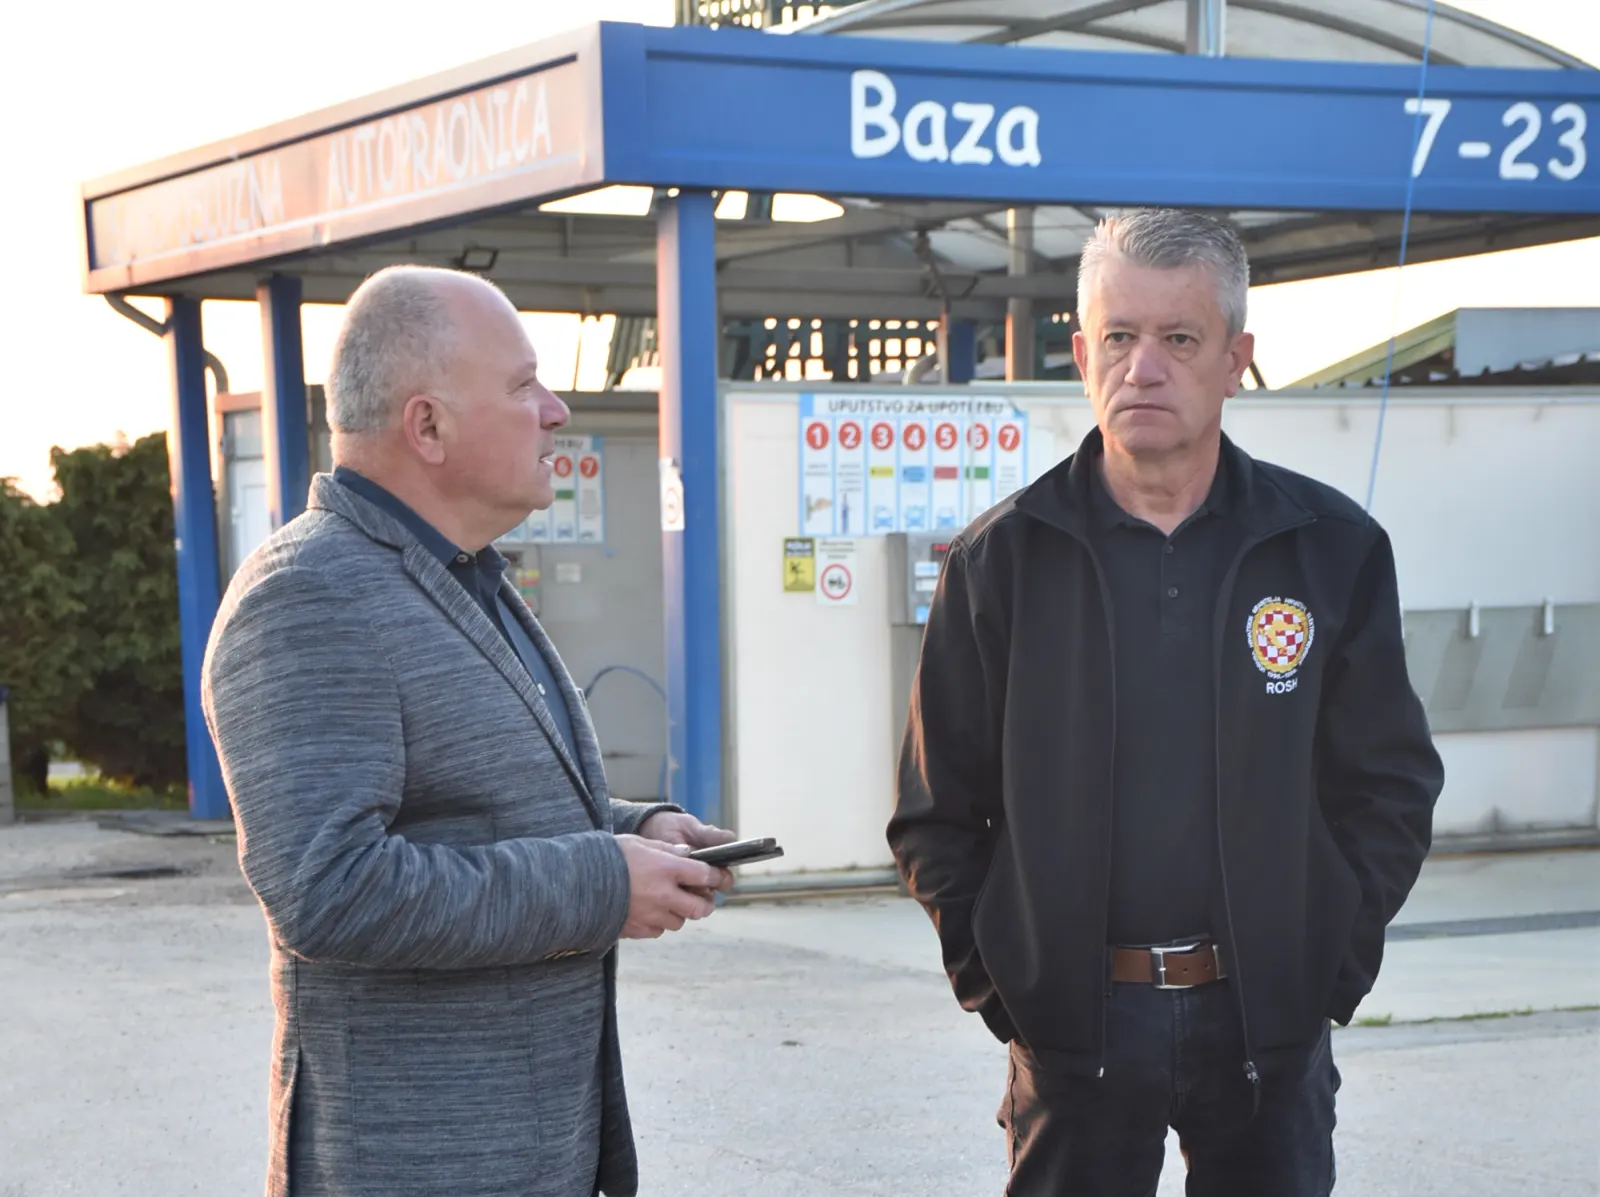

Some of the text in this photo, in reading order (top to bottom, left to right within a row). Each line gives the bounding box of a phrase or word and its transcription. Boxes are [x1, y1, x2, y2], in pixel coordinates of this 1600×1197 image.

[851, 69, 1042, 167] Baza
[327, 78, 553, 212] AUTOPRAONICA
[828, 399, 904, 414] UPUTSTVO
[907, 400, 926, 414] ZA
[843, 426, 857, 447] 2
[876, 426, 889, 447] 3
[907, 428, 922, 448] 4
[940, 427, 953, 447] 5
[1002, 428, 1017, 449] 7
[1266, 677, 1298, 694] ROSH
